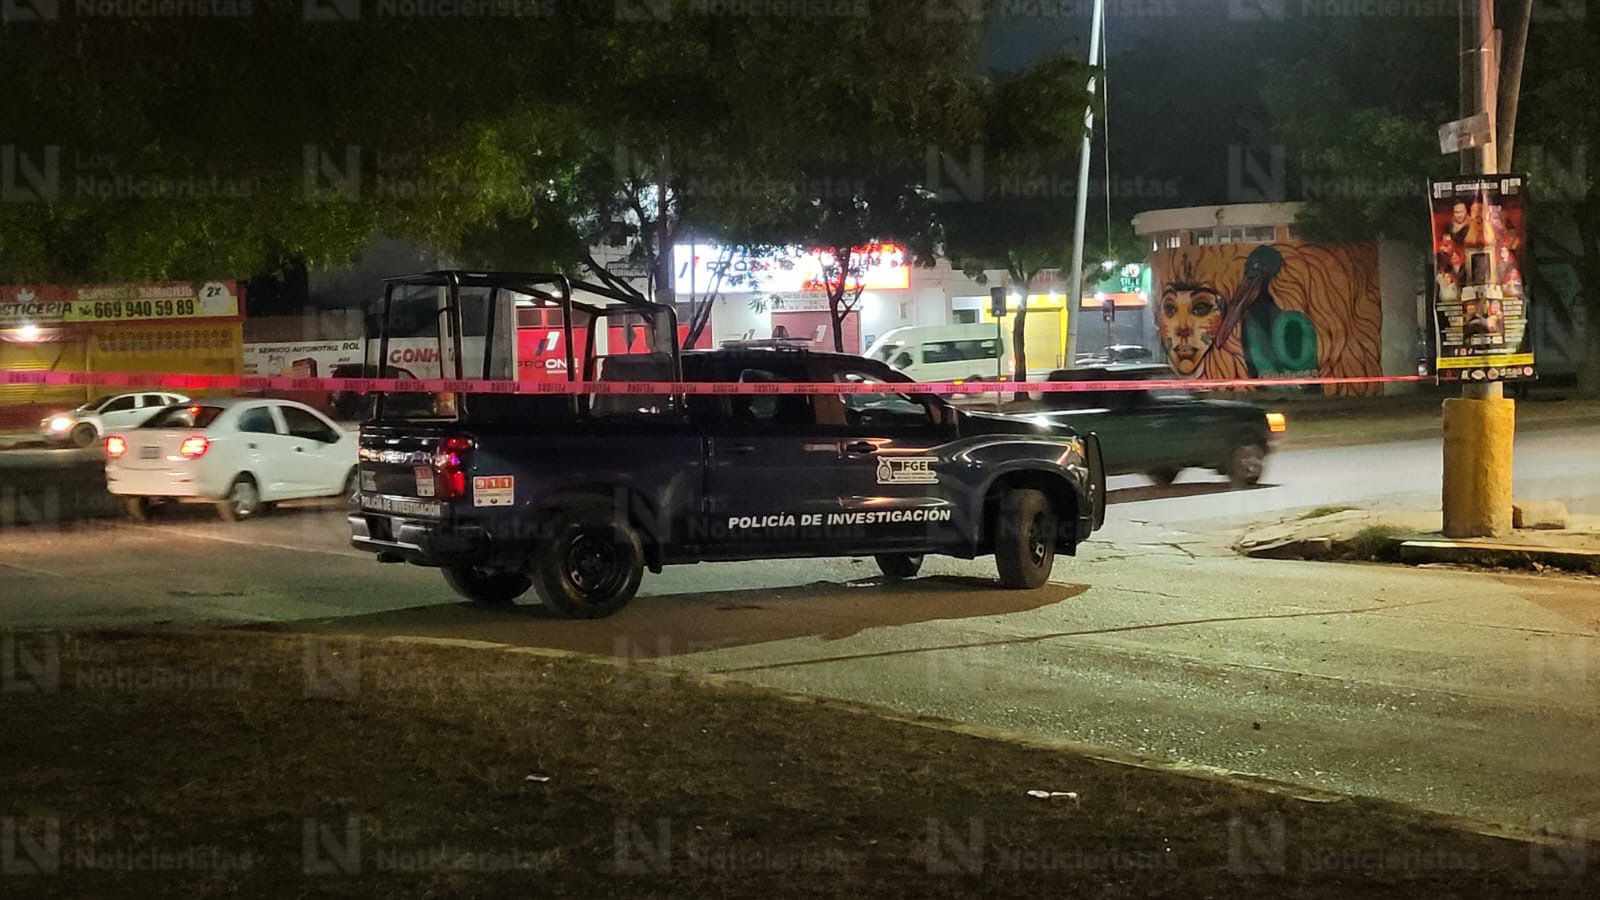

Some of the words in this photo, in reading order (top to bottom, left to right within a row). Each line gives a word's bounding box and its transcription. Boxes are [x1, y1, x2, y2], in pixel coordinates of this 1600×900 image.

[0, 303, 72, 315] STICERIA
[95, 302, 122, 318] 669
[126, 301, 152, 316] 940
[156, 300, 173, 315] 59
[177, 299, 194, 314] 89
[342, 343, 359, 351] ROL
[903, 461, 926, 471] FGE
[728, 512, 795, 529] POLICÍA
[801, 514, 822, 526] DE
[827, 507, 951, 526] INVESTIGACIÓN
